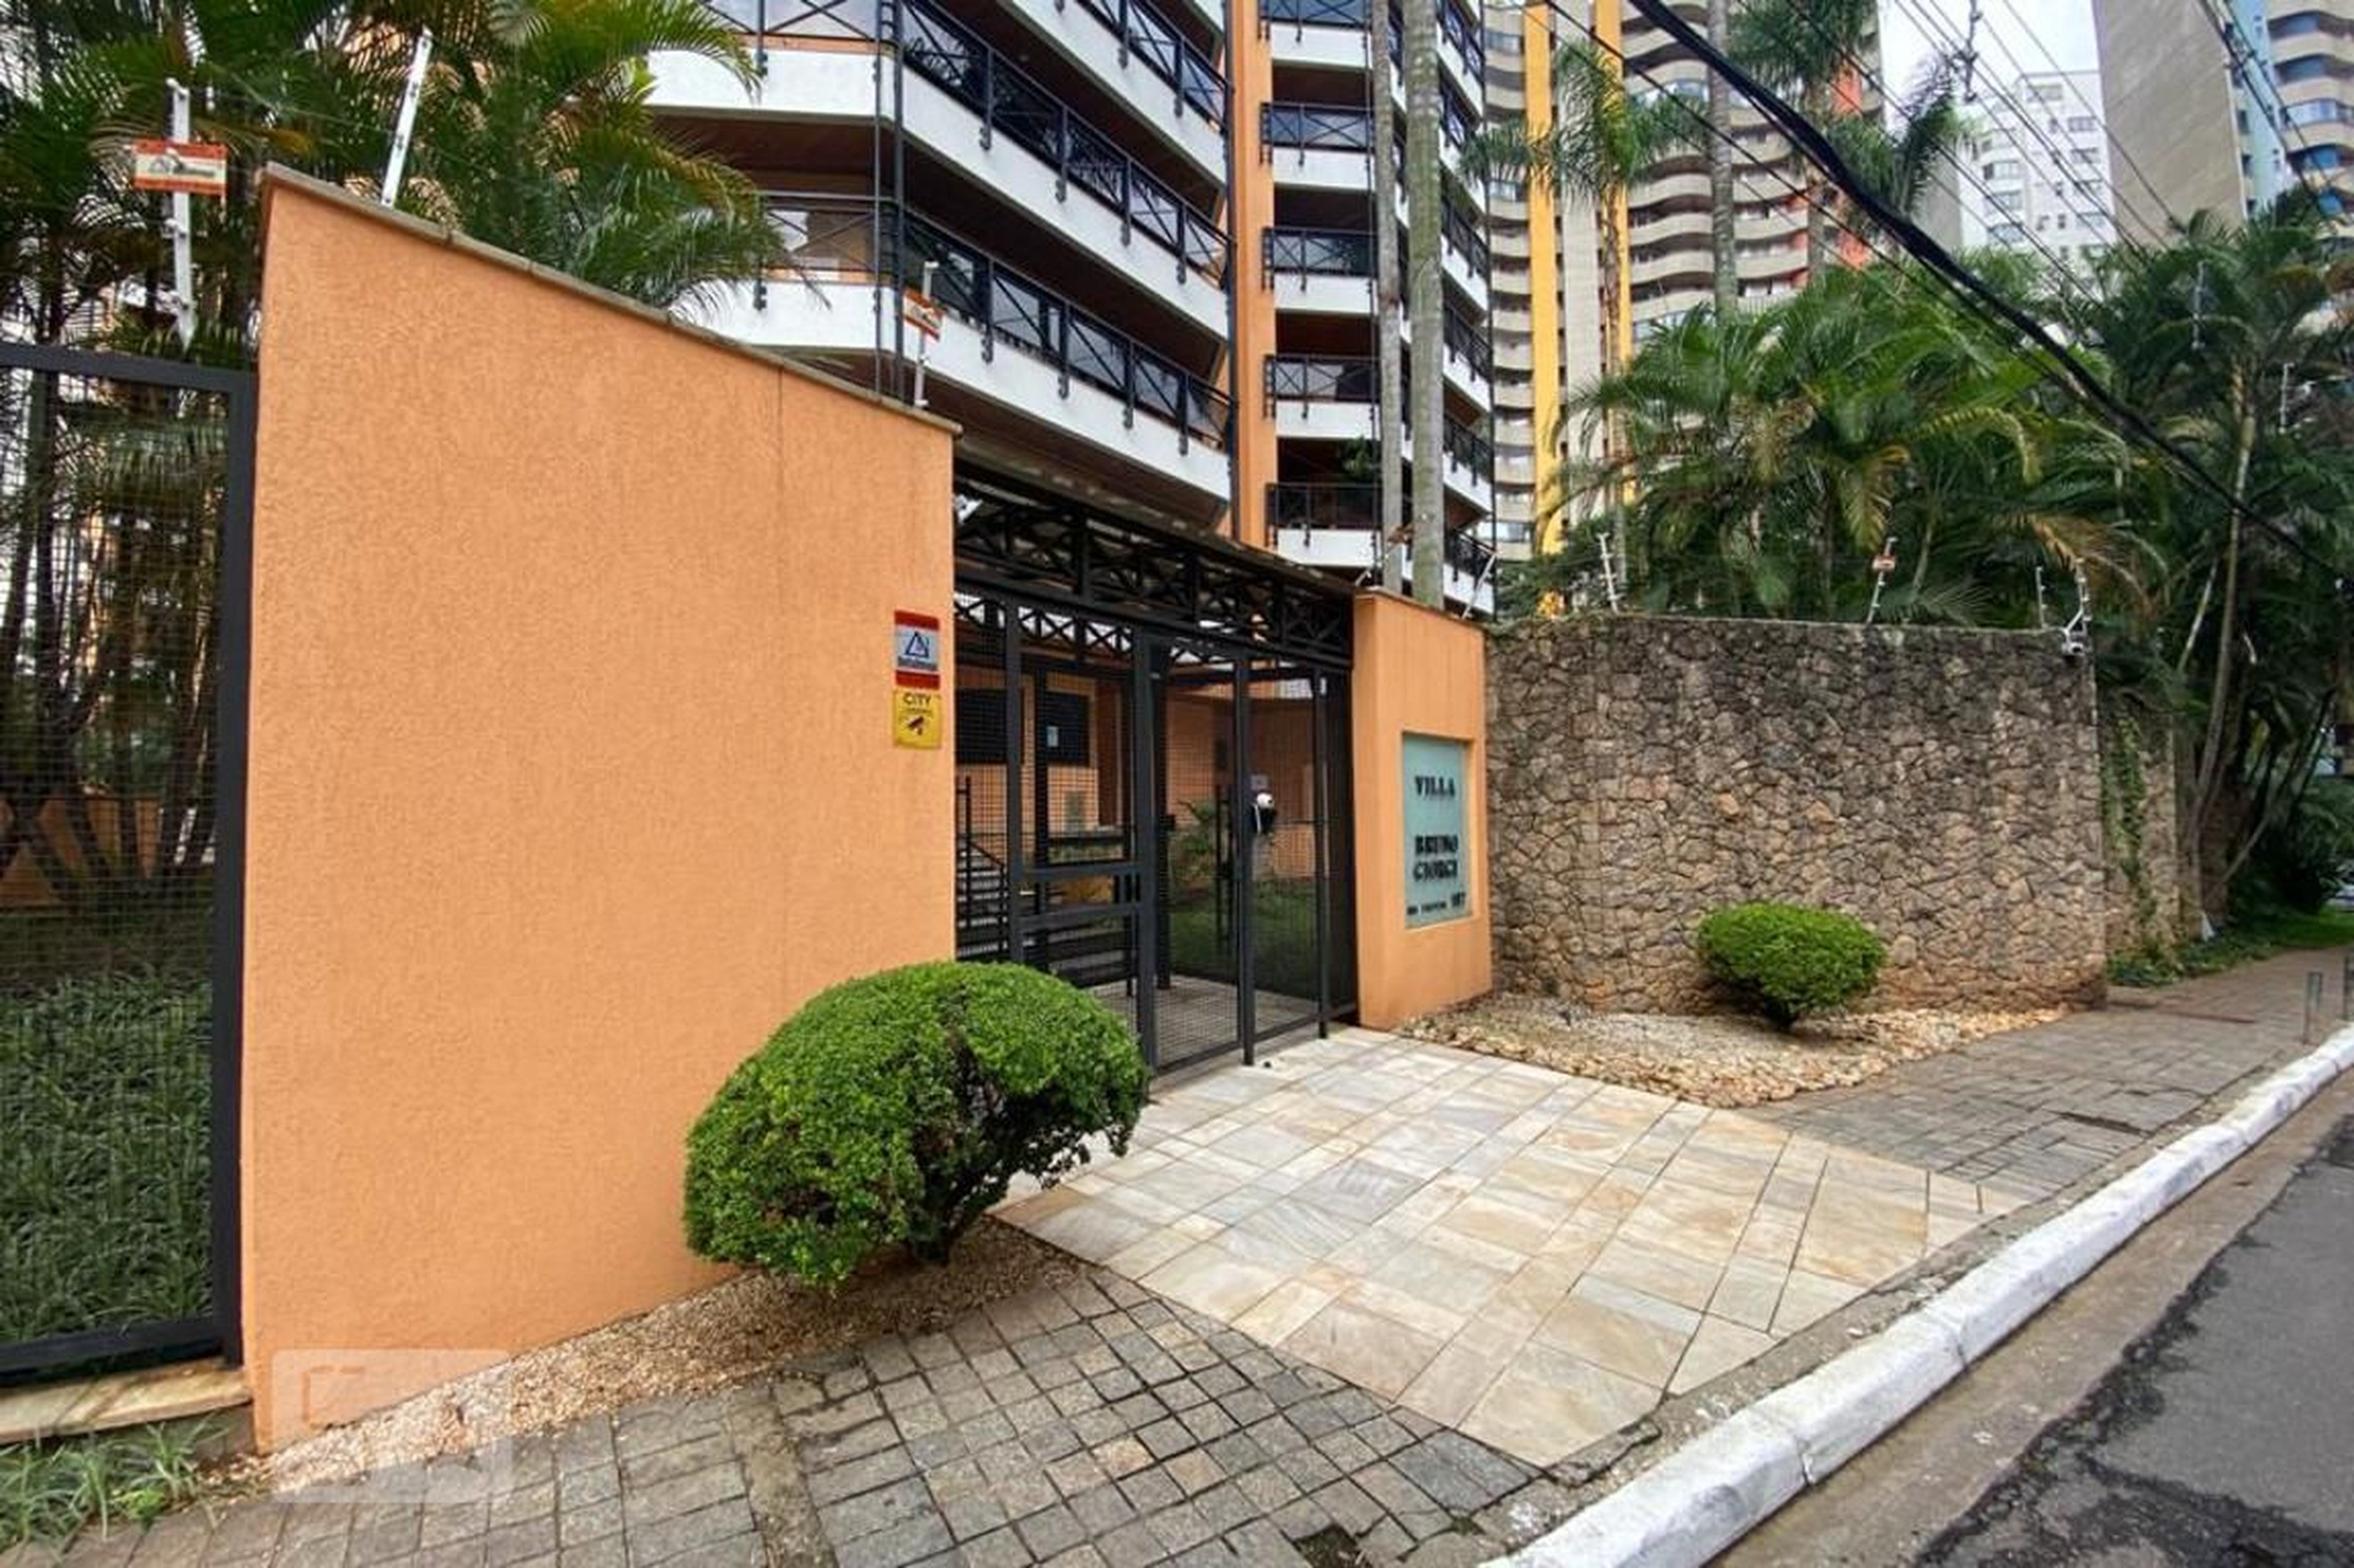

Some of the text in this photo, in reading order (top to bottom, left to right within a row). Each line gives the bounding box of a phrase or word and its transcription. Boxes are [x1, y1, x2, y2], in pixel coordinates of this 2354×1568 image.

[904, 693, 931, 705] CITY
[1415, 776, 1455, 796] VILLA
[1415, 835, 1458, 854] BRUNO
